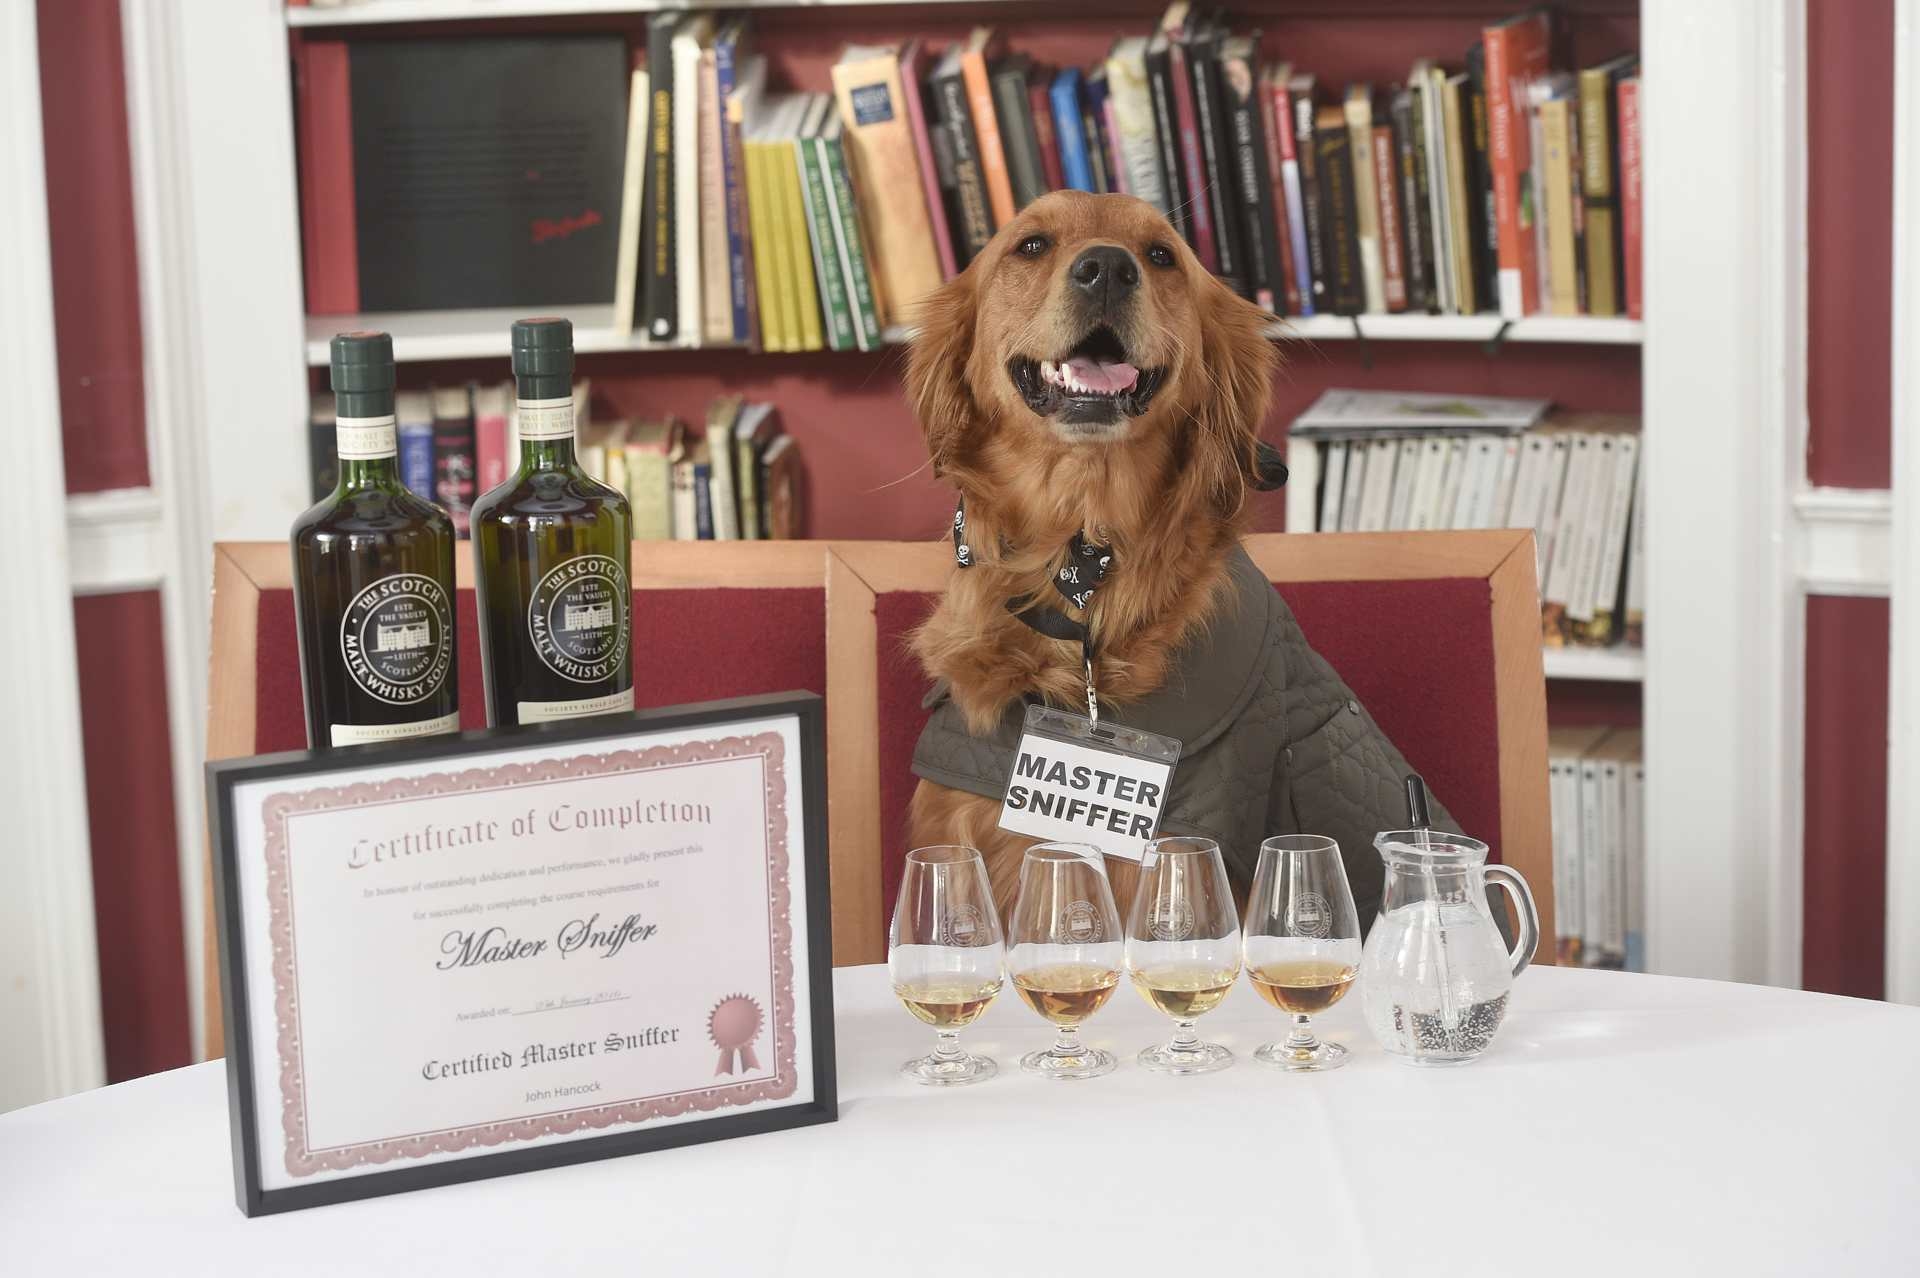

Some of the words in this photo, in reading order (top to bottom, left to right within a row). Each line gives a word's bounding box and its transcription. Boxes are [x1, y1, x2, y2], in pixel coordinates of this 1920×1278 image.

[545, 571, 567, 590] THE
[568, 560, 623, 583] SCOTCH
[358, 592, 380, 610] THE
[381, 579, 441, 604] SCOTCH
[566, 593, 583, 602] THE
[584, 591, 612, 601] VAULTS
[379, 613, 396, 622] THE
[398, 610, 428, 621] VAULTS
[533, 613, 556, 657] MALT
[553, 654, 609, 679] WHISKY
[611, 606, 629, 666] SOCIETY
[567, 635, 613, 656] SCOTLAND
[580, 632, 602, 640] LEITH
[345, 634, 369, 676] MALT
[366, 675, 425, 700] WHISKY
[428, 624, 450, 688] SOCIETY
[380, 656, 430, 677] SCOTLAND
[394, 652, 418, 660] LEITH
[1016, 752, 1161, 809] MASTER
[1006, 785, 1154, 841] SNIFFER
[347, 821, 500, 870] Certificate
[511, 808, 536, 837] of
[549, 799, 712, 832] Completion
[376, 884, 409, 896] honour
[412, 881, 423, 892] of
[424, 876, 477, 891] outstanding
[479, 868, 527, 883] dedication
[527, 865, 545, 876] and
[547, 859, 607, 875] performance,
[608, 857, 621, 865] we
[623, 852, 651, 866] gladly
[653, 847, 685, 860] present
[686, 843, 704, 855] this
[412, 910, 427, 920] for
[429, 903, 484, 918] successfully
[487, 896, 538, 910] completing
[540, 893, 553, 902] the
[556, 889, 585, 901] course
[587, 880, 645, 897] requirements
[647, 878, 660, 889] for
[436, 926, 549, 970] Master
[557, 912, 658, 960] Sniffer
[455, 1007, 496, 1022] Awarded
[421, 1050, 512, 1081] Certified
[520, 1039, 598, 1068] Master
[603, 1026, 680, 1054] Sniffer
[525, 1087, 551, 1104] John
[554, 1080, 602, 1098] Hancock
